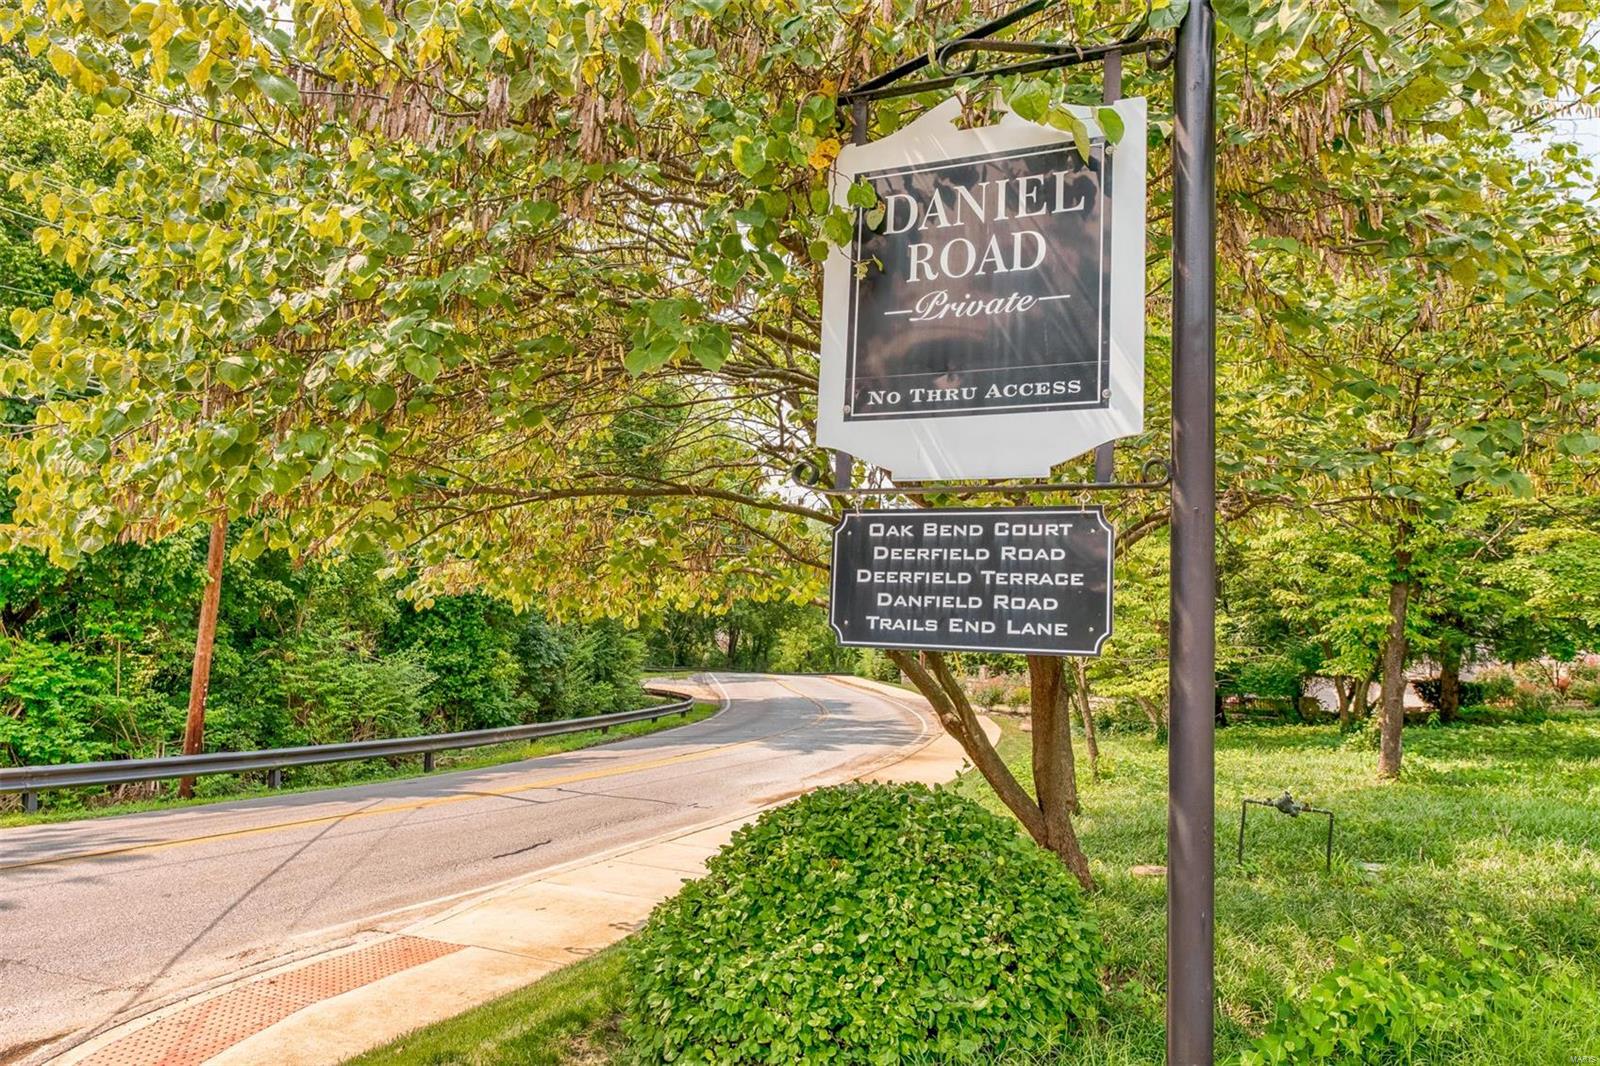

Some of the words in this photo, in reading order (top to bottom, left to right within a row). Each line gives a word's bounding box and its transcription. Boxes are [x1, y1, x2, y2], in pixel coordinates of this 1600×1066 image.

[882, 170, 1085, 235] DANIEL
[906, 230, 1046, 283] ROAD
[909, 288, 1039, 322] Private
